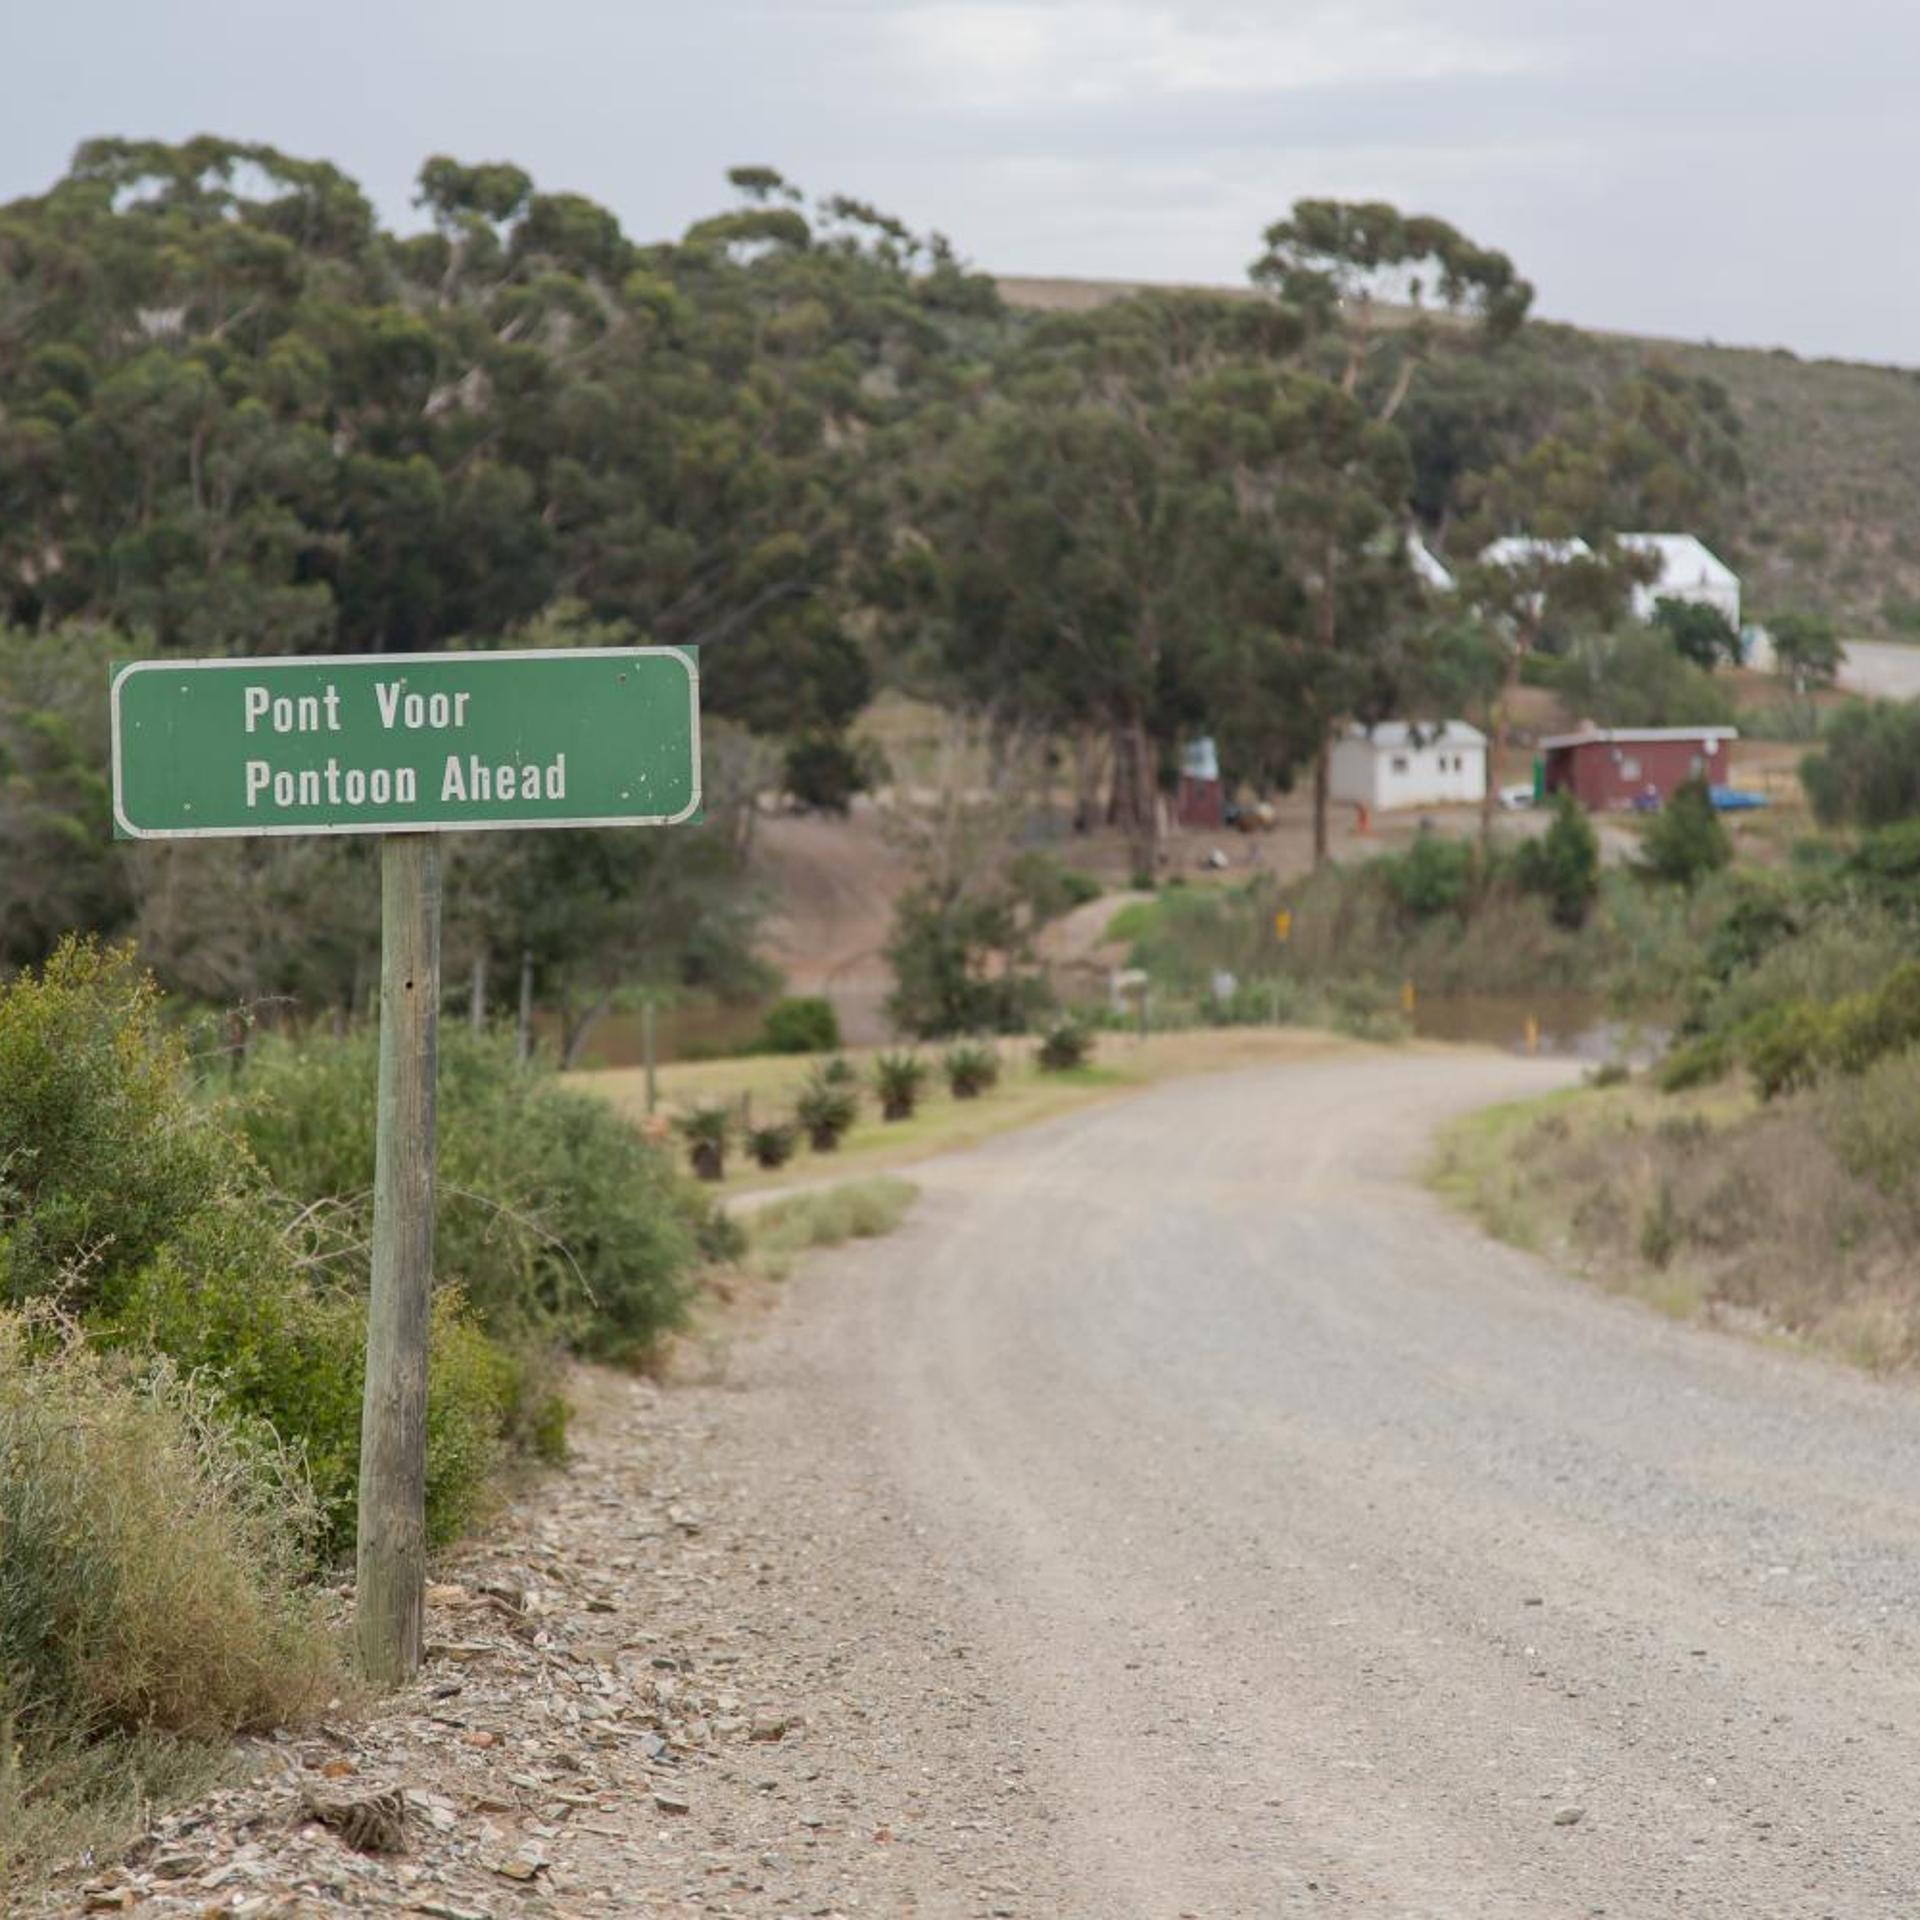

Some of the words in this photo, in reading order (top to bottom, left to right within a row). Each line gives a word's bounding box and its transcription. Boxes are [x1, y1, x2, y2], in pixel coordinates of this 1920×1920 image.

[245, 685, 340, 732] Pont
[376, 682, 470, 728] Voor
[246, 759, 416, 806] Pontoon
[441, 753, 566, 802] Ahead
